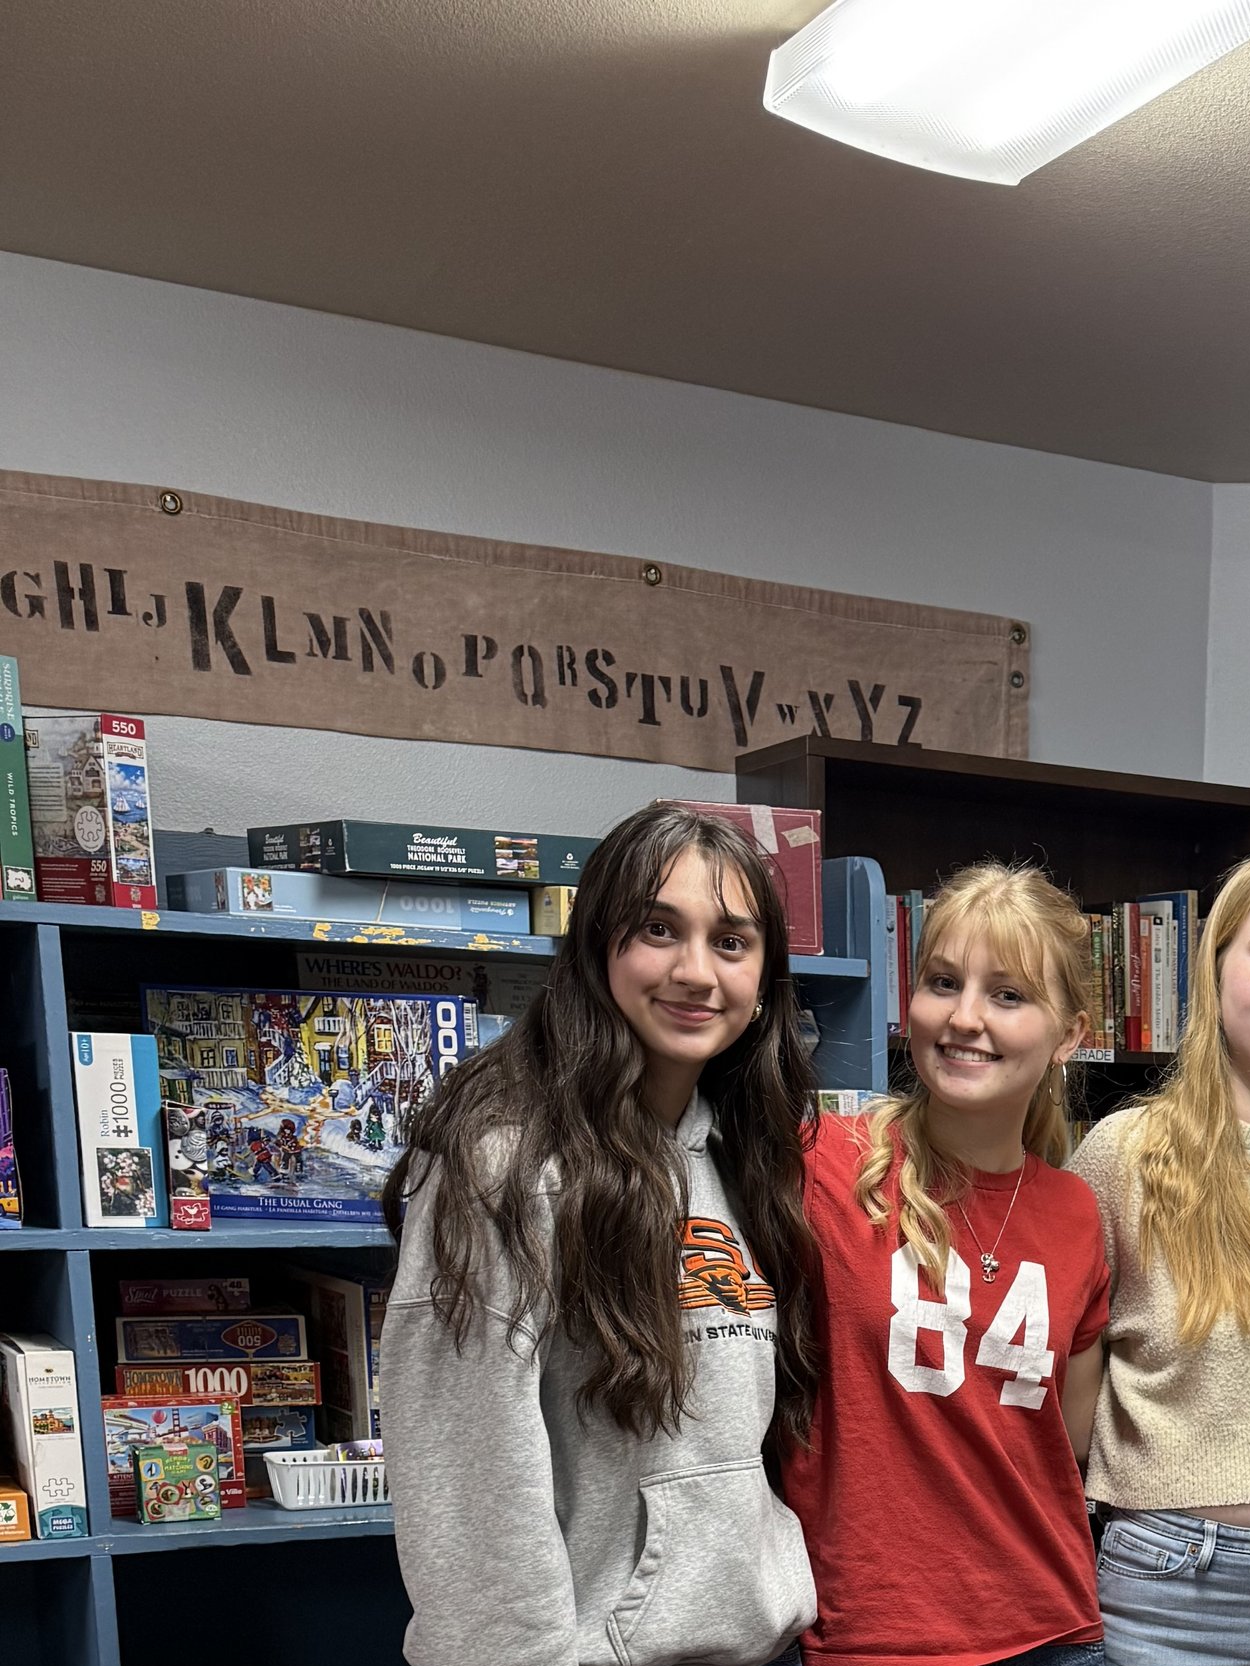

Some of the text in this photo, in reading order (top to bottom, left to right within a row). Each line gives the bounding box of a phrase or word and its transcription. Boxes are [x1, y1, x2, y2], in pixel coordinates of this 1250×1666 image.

[112, 720, 136, 735] 550
[108, 742, 144, 756] HEARTLAND
[7, 772, 18, 836] WILD TROPICS
[413, 833, 458, 847] Beautiful
[408, 852, 467, 863] NATIONAL PARK
[91, 860, 107, 872] 550
[400, 895, 455, 914] 1000
[305, 958, 462, 981] WHERE'S WALDO?
[322, 977, 450, 992] THE LAND OF WALDOS
[1071, 1049, 1112, 1062] GRADE
[110, 1082, 130, 1123] 1000
[100, 1109, 110, 1138] Robin
[258, 1197, 343, 1209] THE USUAL GANG
[162, 1288, 203, 1297] PUZZLE
[706, 1324, 752, 1340] STATE
[888, 1241, 1054, 1410] 84
[238, 1335, 261, 1347] 500
[124, 1369, 183, 1386] HOMETOWN
[184, 1367, 248, 1398] 1000
